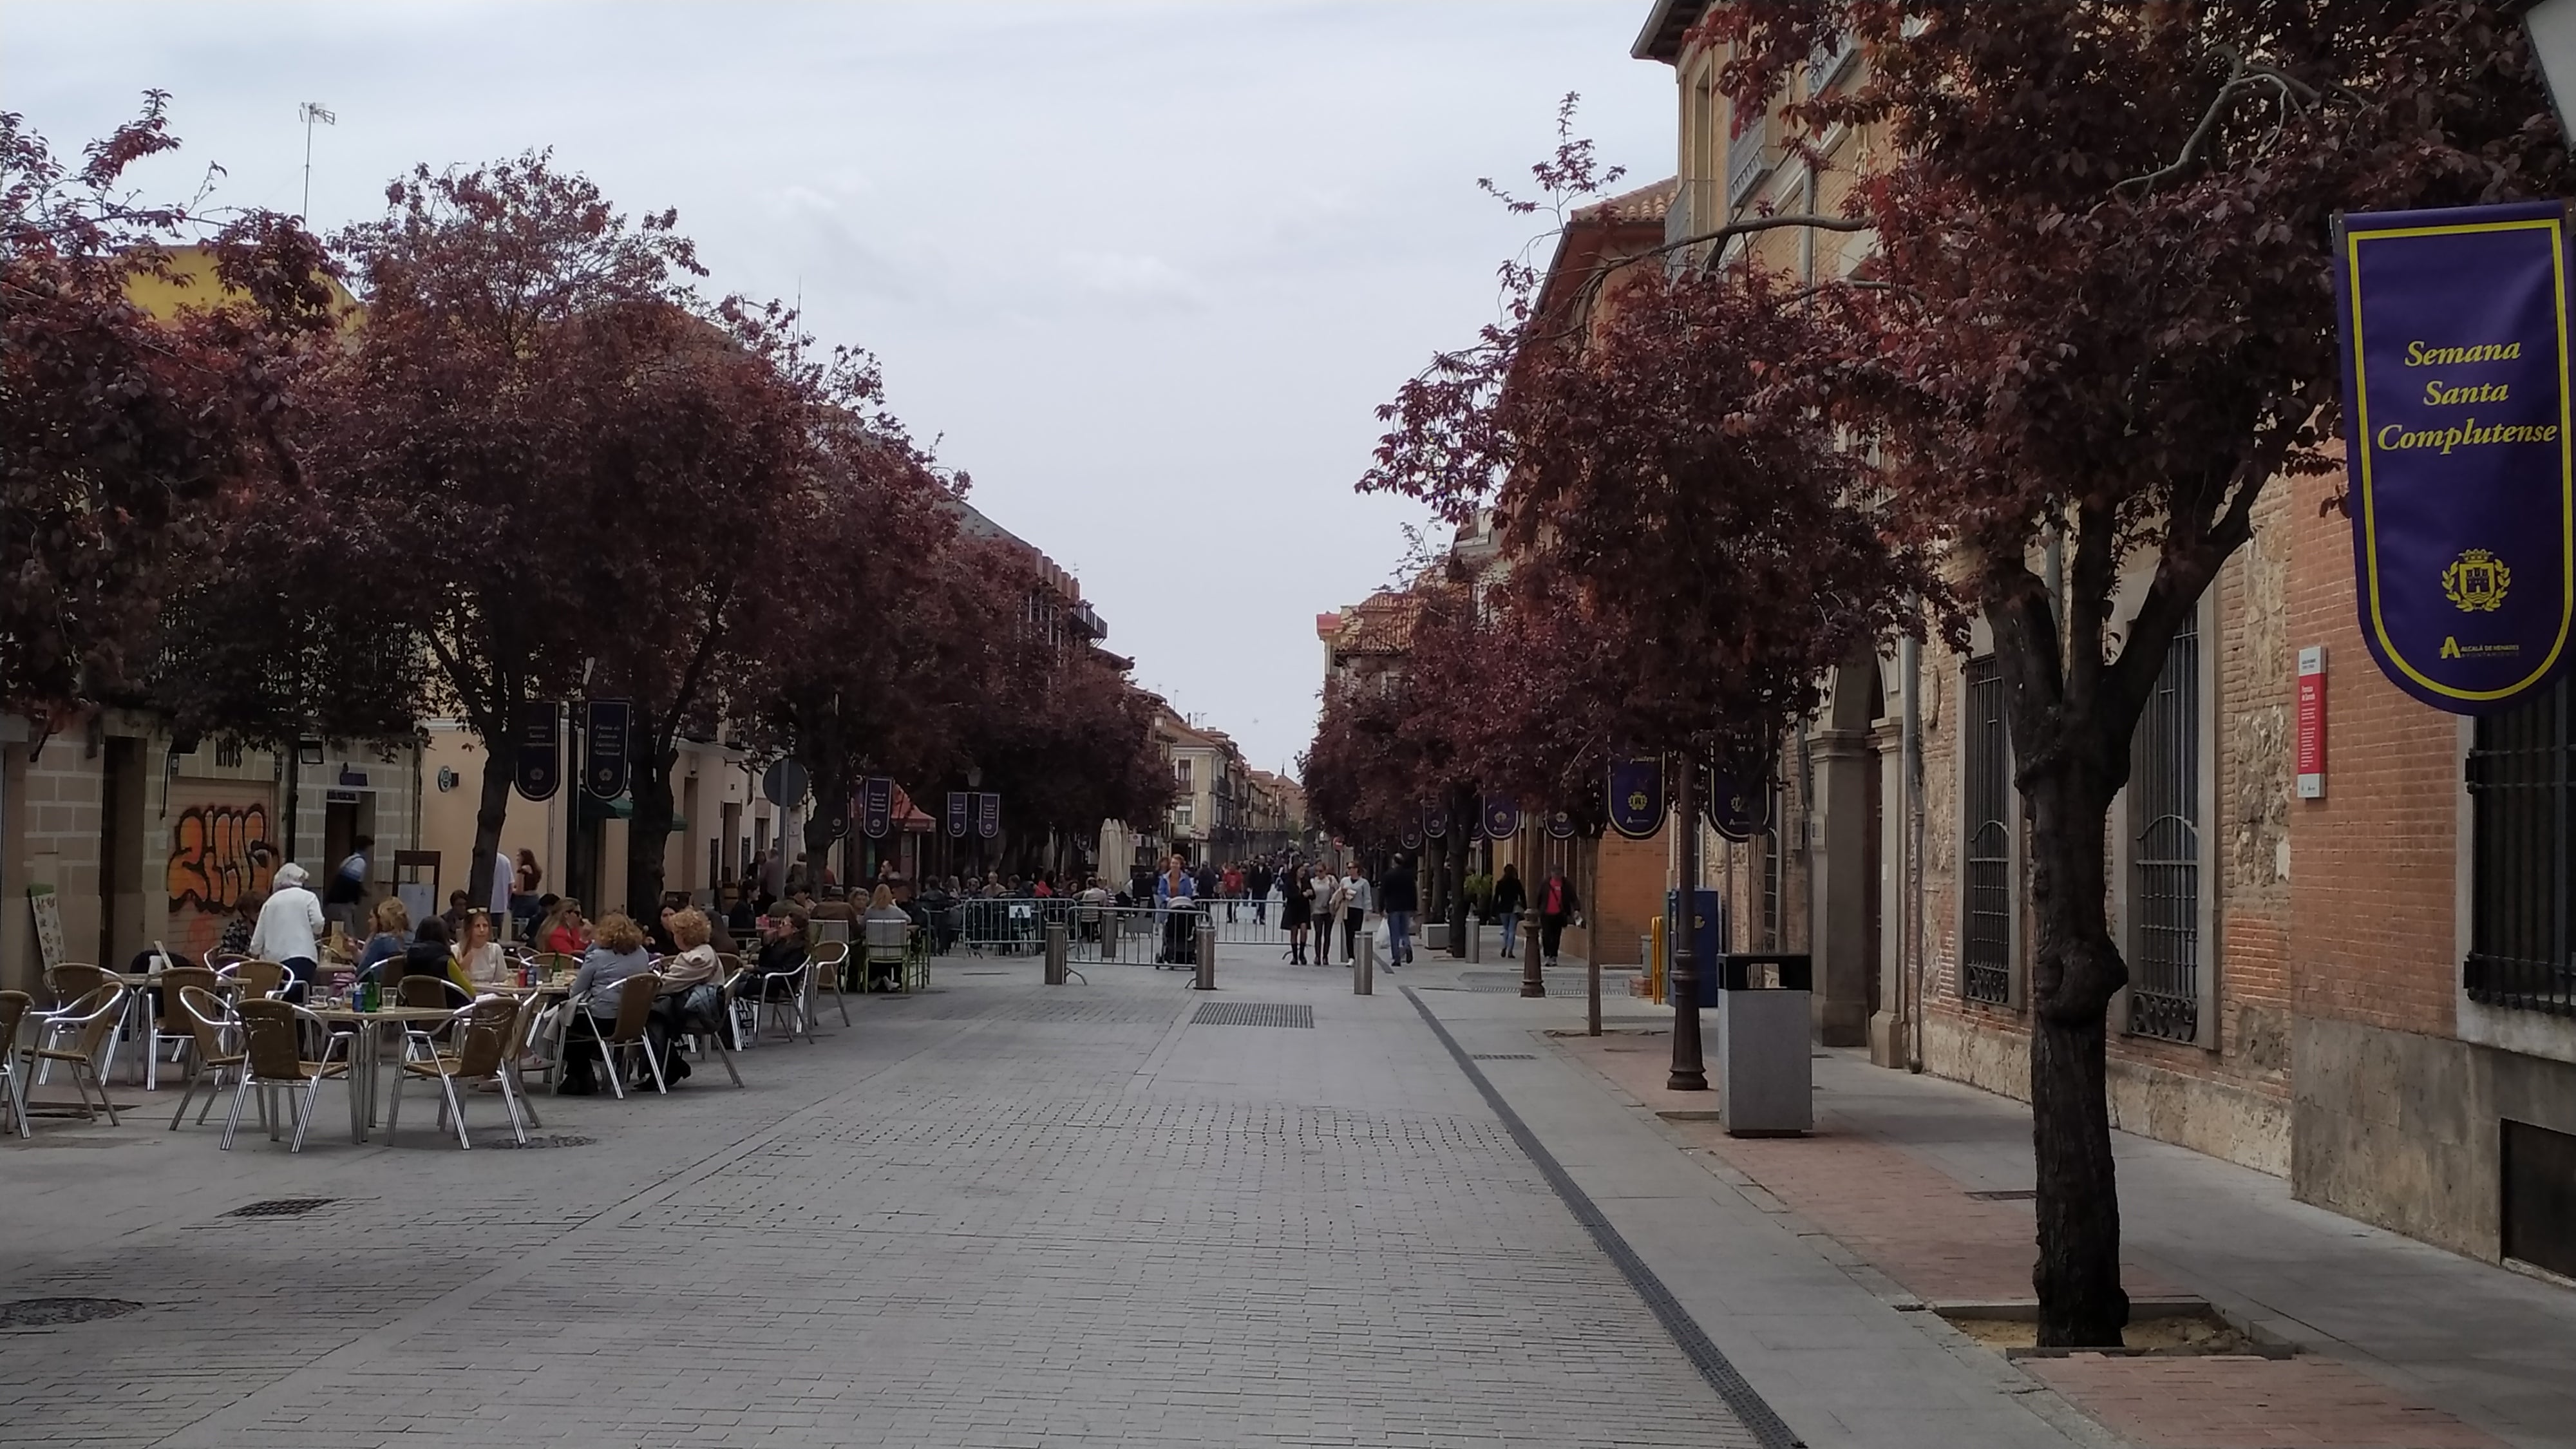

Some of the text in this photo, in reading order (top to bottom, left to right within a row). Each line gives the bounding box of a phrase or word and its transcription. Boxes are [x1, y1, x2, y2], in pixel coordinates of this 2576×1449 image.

[2404, 340, 2522, 367] Semana
[2423, 380, 2509, 406] Santa
[2377, 417, 2558, 455] Complutense
